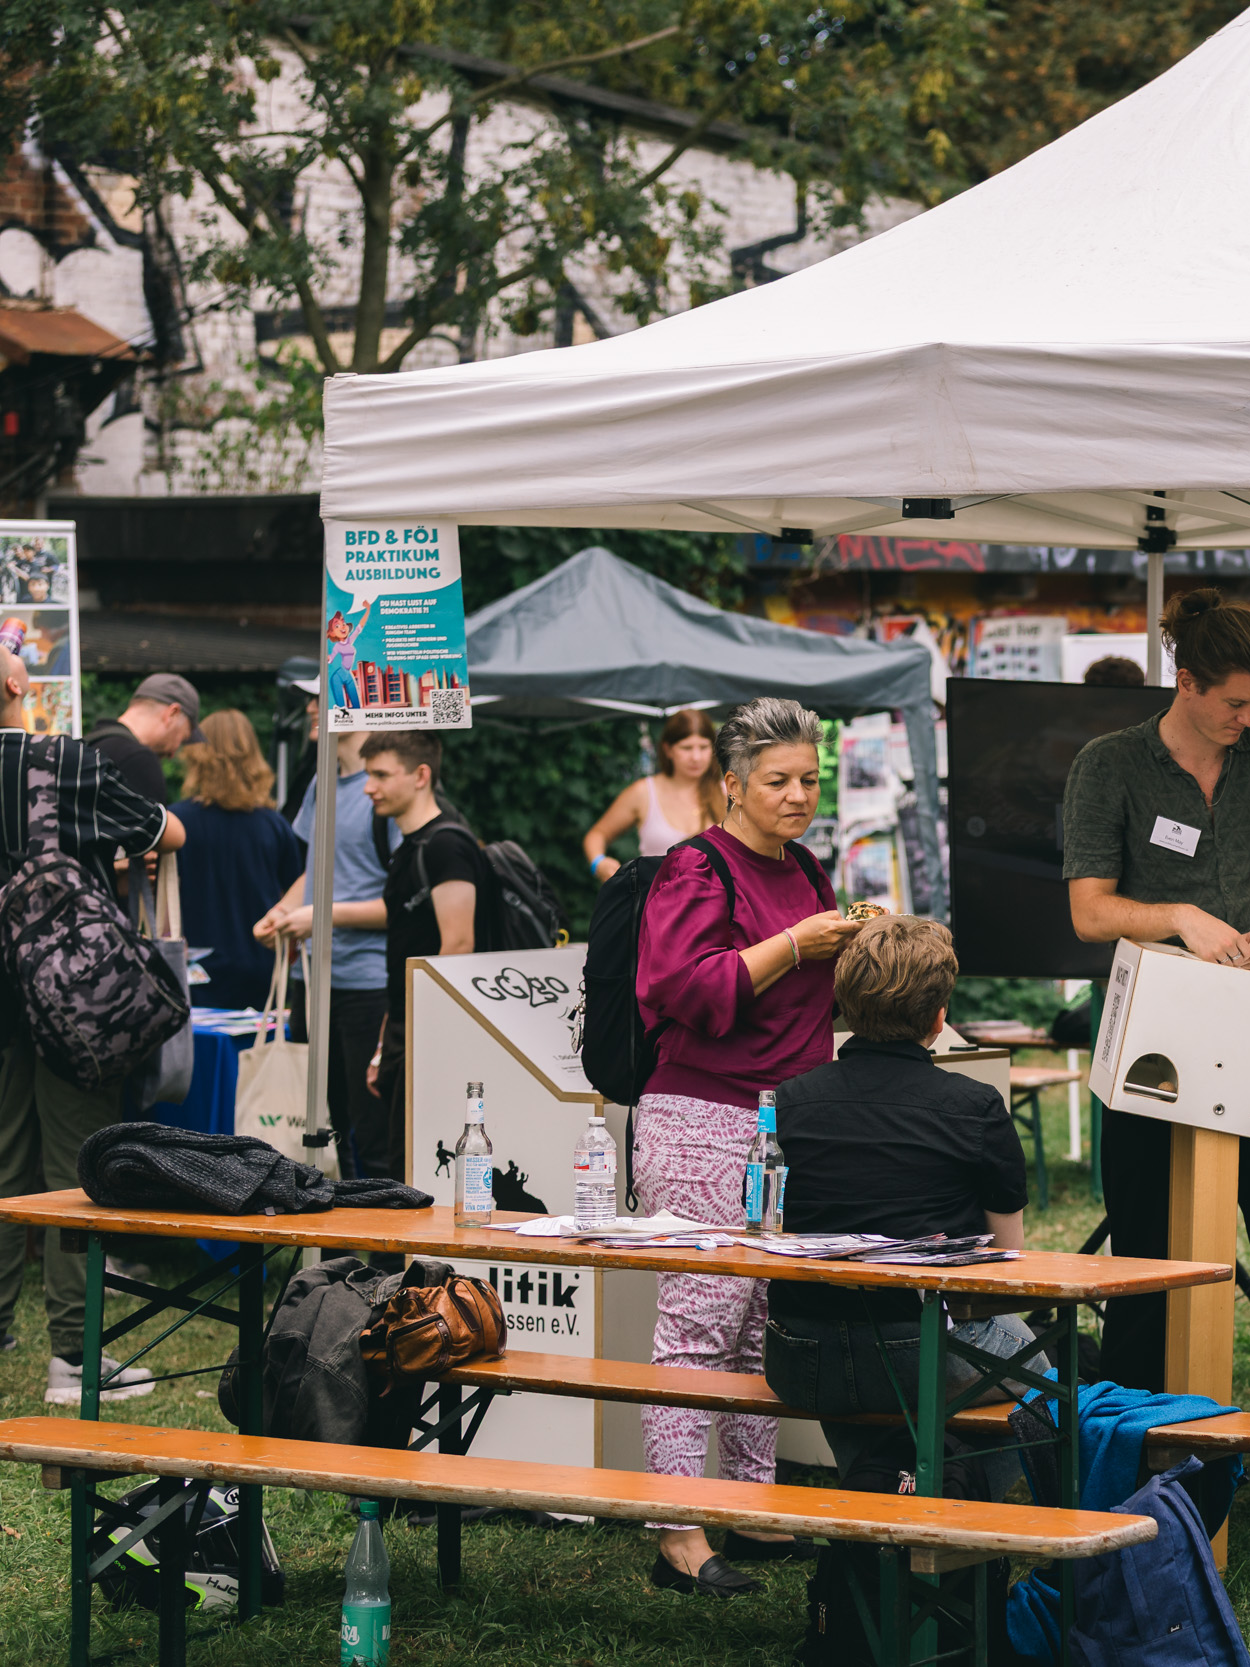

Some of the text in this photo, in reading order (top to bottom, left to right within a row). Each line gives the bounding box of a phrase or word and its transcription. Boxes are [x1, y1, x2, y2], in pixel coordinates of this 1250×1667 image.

[345, 526, 438, 545] BFD & FÖJ
[345, 549, 439, 563] PRAKTIKUM
[345, 567, 440, 580] AUSBILDUNG
[551, 1313, 579, 1336] e.V.
